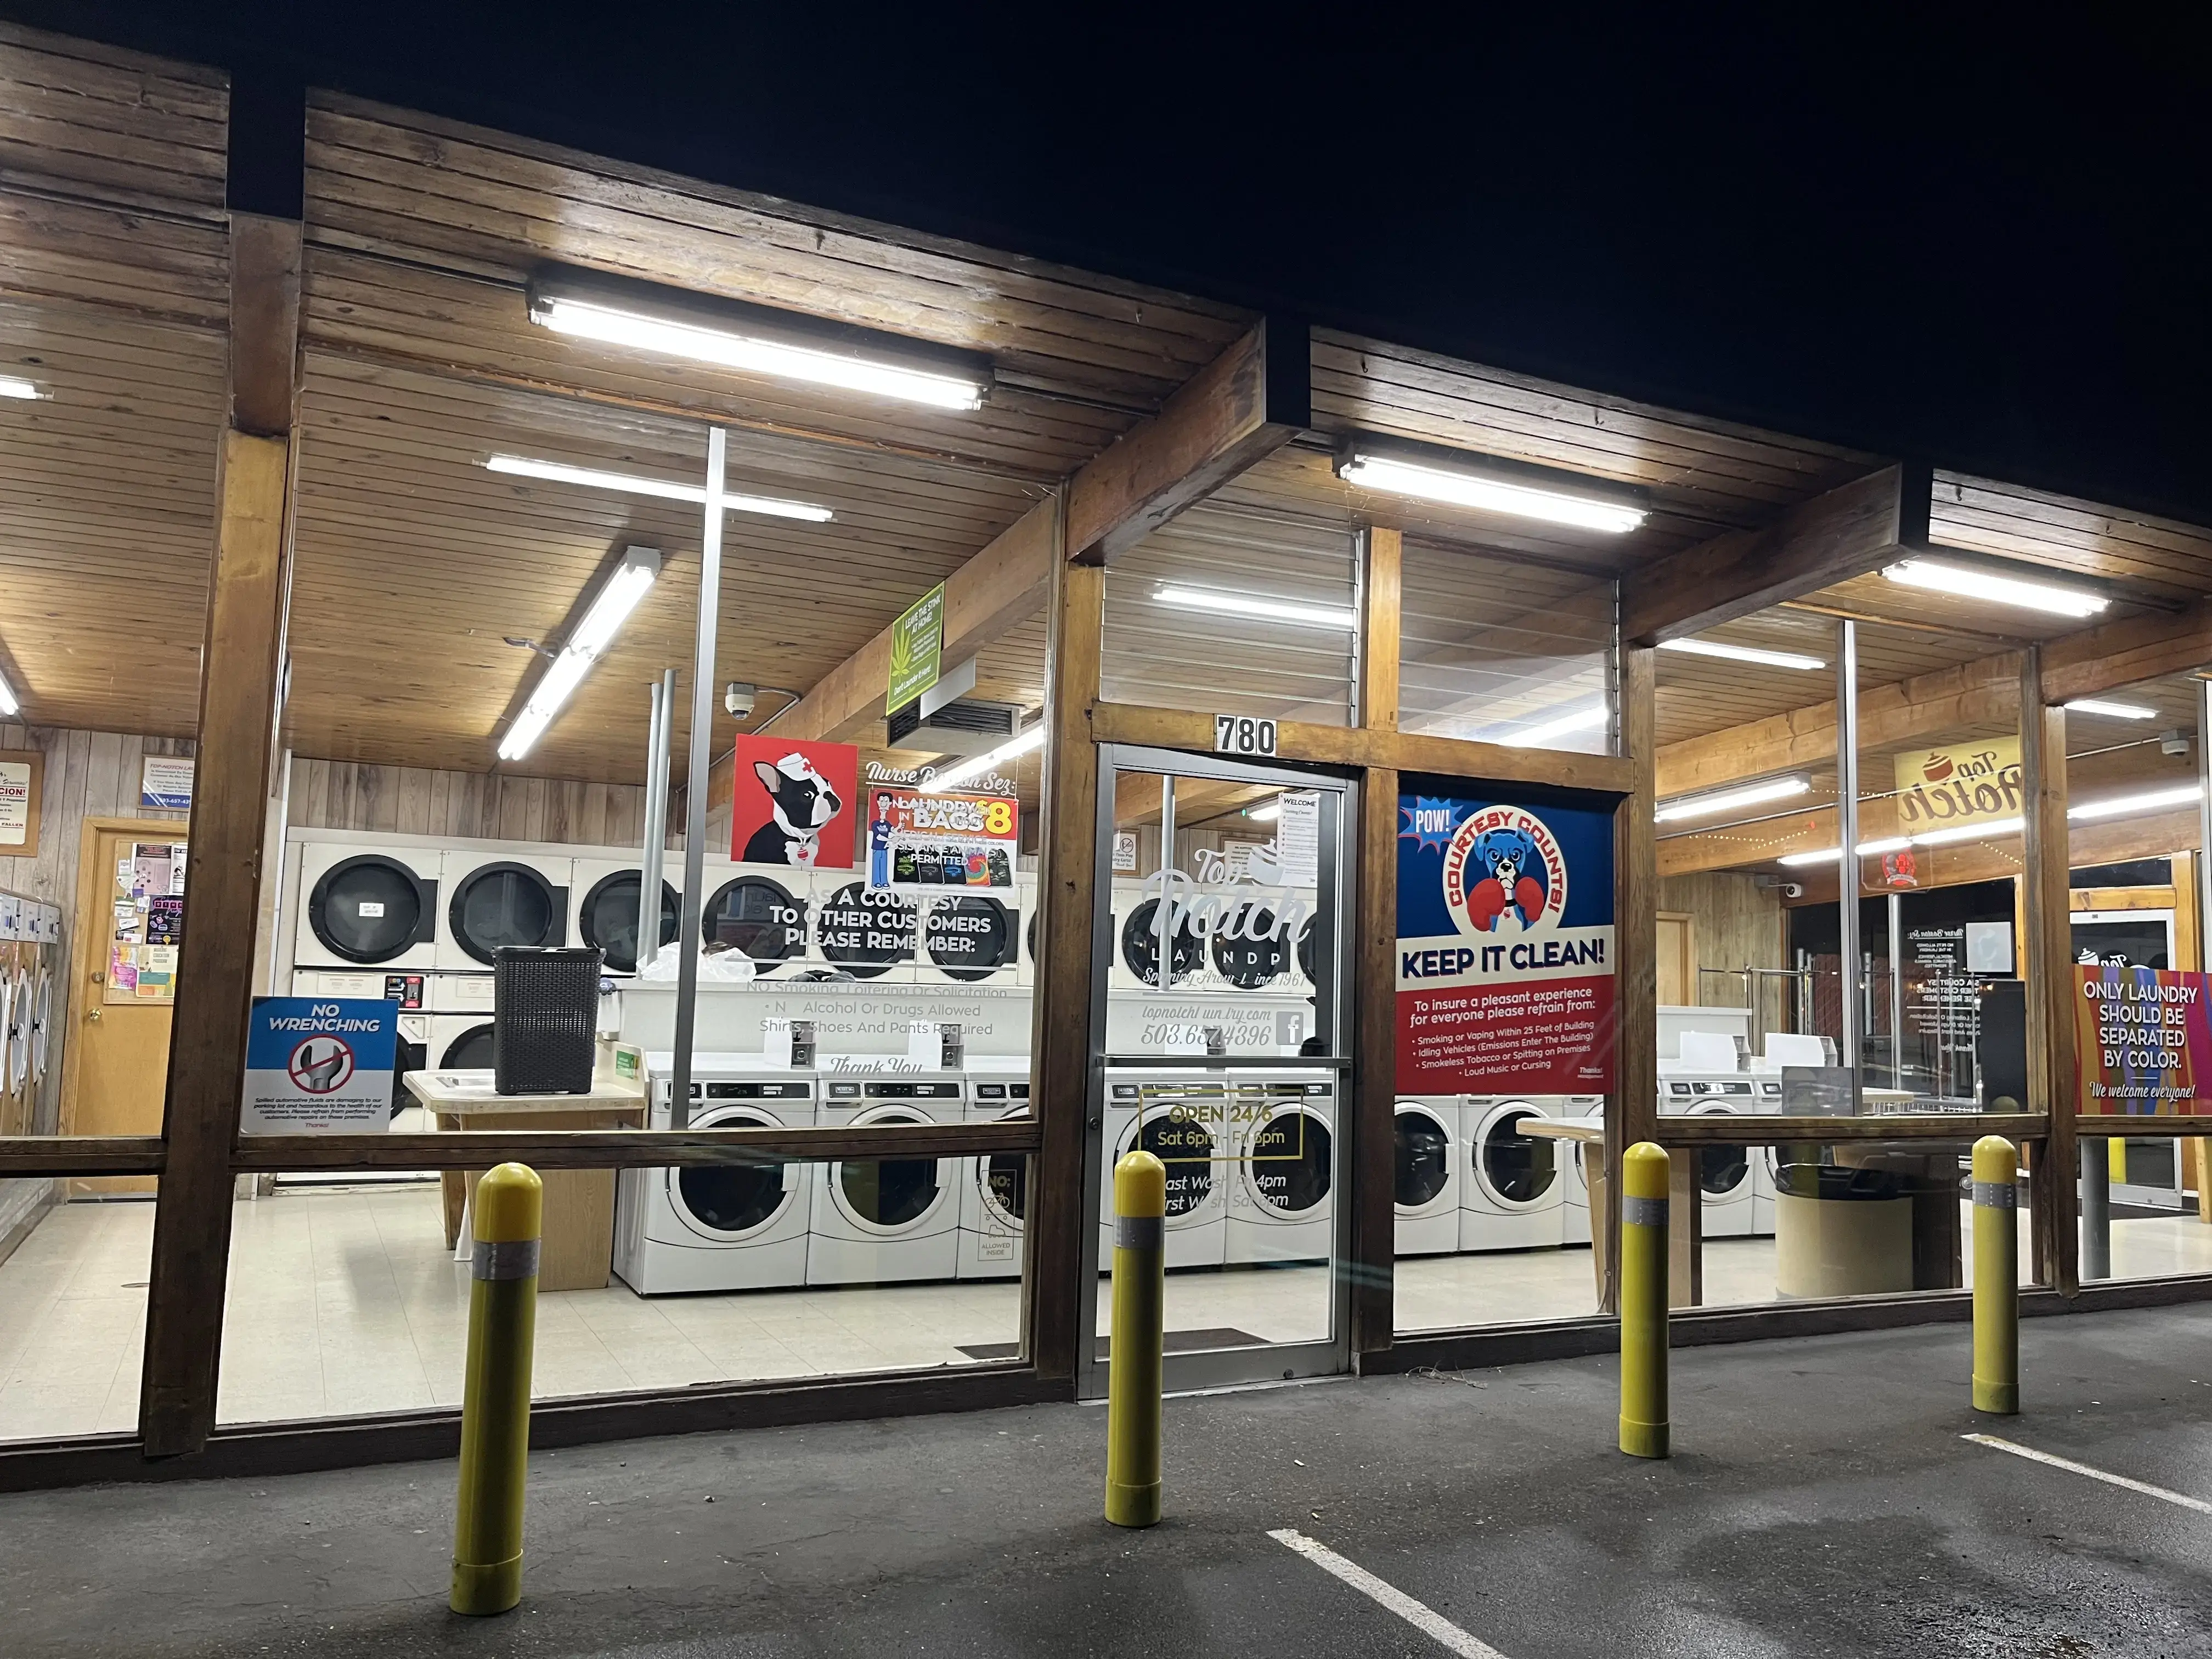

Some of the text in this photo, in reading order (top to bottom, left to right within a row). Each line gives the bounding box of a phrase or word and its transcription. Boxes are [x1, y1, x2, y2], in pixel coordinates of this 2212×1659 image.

[905, 592, 941, 630] LEAVE THE STINK
[911, 621, 918, 635] AT
[1218, 716, 1274, 753] 780
[866, 761, 1016, 796] Nurse Bon Sez:
[1284, 798, 1317, 807] WELCOME
[898, 796, 977, 816] LAUNDRY
[976, 799, 1012, 834] $8
[913, 808, 985, 832] BAGS
[1416, 809, 1450, 834] POW!
[884, 842, 948, 855] ASSISTANCE
[911, 854, 970, 867] PERMITTED.
[1194, 849, 1243, 887] Top
[1448, 811, 1564, 913] COURTESY COUNTS!
[804, 887, 962, 912] AS A COURTESY
[1142, 868, 1310, 943] Notch
[770, 905, 991, 933] TO OTHER CUSTOMERS
[785, 928, 976, 952] PLEASE REMEMBER:
[1402, 939, 1604, 979] KEEP IT CLEAN!
[1143, 967, 1307, 987] Spning 1961
[913, 986, 930, 997] Or
[1414, 988, 1592, 1012] To insure a pleasant experience
[2084, 981, 2198, 1003] ONLY LAUNDRY
[311, 1004, 340, 1017] NO
[803, 1001, 981, 1017] Alcohol Or Drugs Allowed
[1410, 1000, 1595, 1028] for everyone please refrain from:
[2099, 1004, 2184, 1025] SHOULD BE
[269, 1017, 381, 1032] WRENCHING
[759, 1020, 992, 1037] Shirts, Shoes And Pants Required
[1418, 1034, 1453, 1046] Smoking
[1466, 1030, 1494, 1041] Vaping
[1497, 1028, 1522, 1037] Within
[1523, 1026, 1533, 1035] 25
[1535, 1024, 1553, 1033] Feet
[1554, 1023, 1563, 1032] of
[1564, 1021, 1594, 1031] Building
[1418, 1032, 1594, 1058] Idling Vehicles (Emissions Enter The Building)
[2100, 1028, 2185, 1046] SEPARATED
[831, 1057, 923, 1076] Thank You
[1421, 1057, 1464, 1069] Smokeless
[1467, 1054, 1500, 1064] Tobacco
[1513, 1049, 1543, 1061] Spitting
[1545, 1048, 1555, 1056] on
[1557, 1044, 1590, 1055] Premises
[2104, 1049, 2182, 1068] BY COLOR.
[1465, 1068, 1485, 1077] Loud
[1487, 1065, 1509, 1075] Music
[1522, 1060, 1551, 1071] Cursing
[2089, 1081, 2196, 1103] We welcome everyone!
[1169, 1105, 1273, 1127] OPEN 24/6
[1158, 1130, 1182, 1146] Sat
[1186, 1131, 1218, 1147] 6pm
[1254, 1131, 1285, 1147] 6pm
[988, 1175, 1011, 1188] NO:
[1165, 1175, 1188, 1190] ast
[1255, 1175, 1286, 1190] 4pm
[1165, 1195, 1185, 1211] irst
[1259, 1193, 1289, 1210] 6pm
